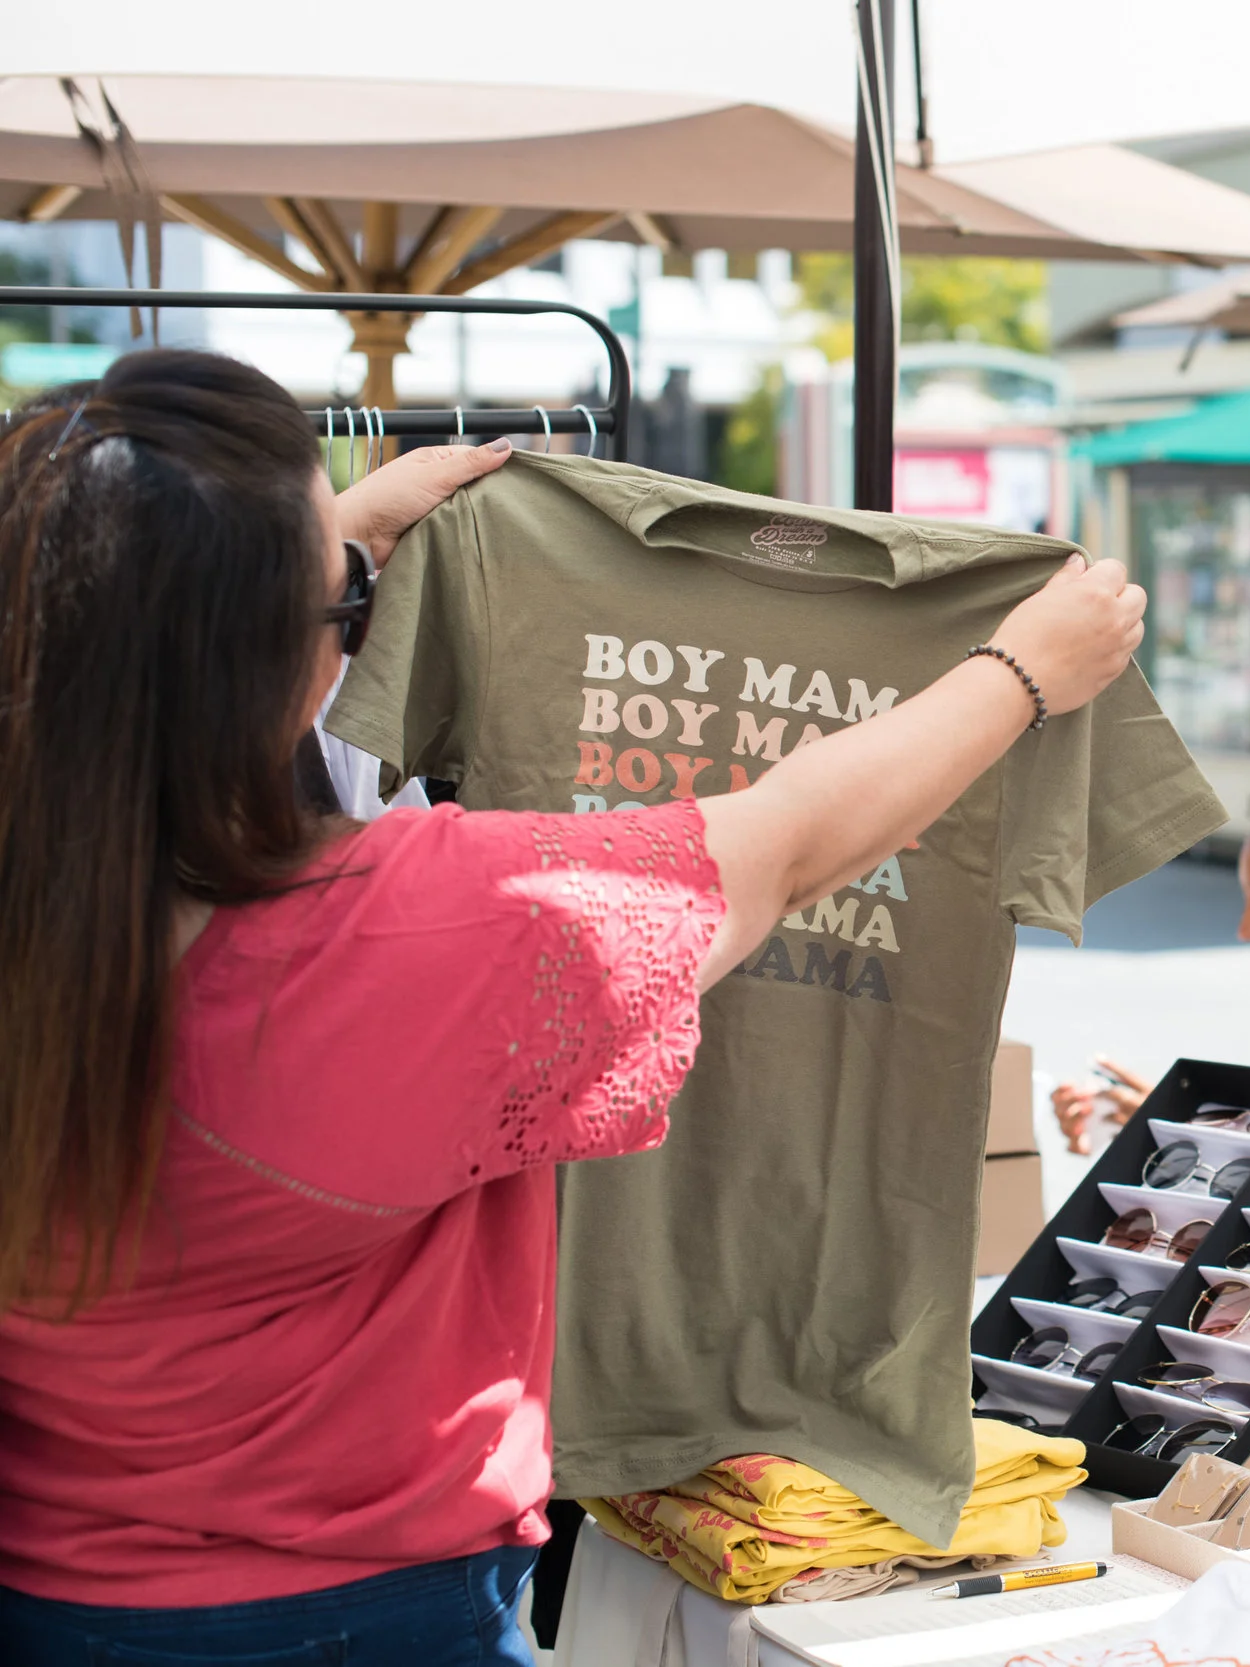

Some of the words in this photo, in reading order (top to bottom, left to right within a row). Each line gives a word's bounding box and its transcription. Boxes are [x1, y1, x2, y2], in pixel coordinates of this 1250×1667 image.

[753, 527, 826, 544] Dream
[583, 634, 725, 692] BOY
[738, 657, 899, 722] MAM
[579, 688, 720, 746] BOY
[574, 741, 713, 799] BOY
[733, 936, 893, 1002] AMA
